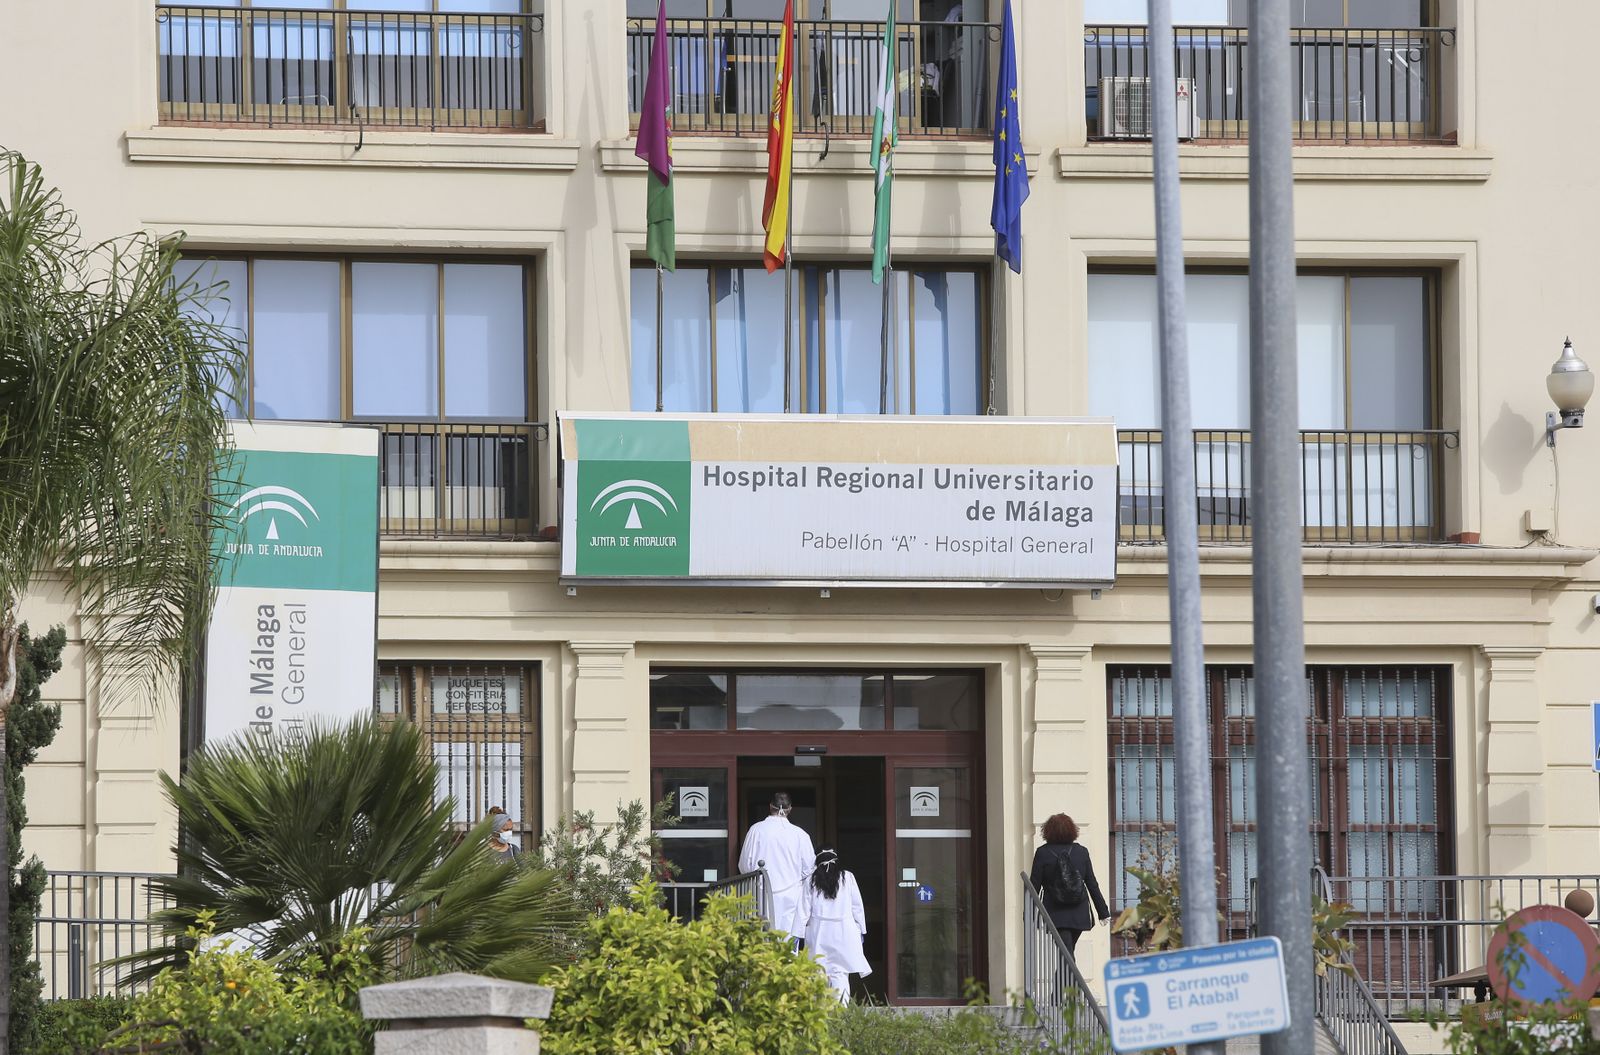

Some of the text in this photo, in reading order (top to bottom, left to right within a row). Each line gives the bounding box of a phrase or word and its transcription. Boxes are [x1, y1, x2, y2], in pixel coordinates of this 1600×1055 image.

[703, 465, 1094, 496] Hospital Regional Universitario
[965, 500, 1094, 528] de Málaga
[258, 544, 270, 556] DE
[590, 536, 616, 547] JUNTA
[620, 536, 630, 547] DE
[801, 531, 883, 553] Pabellón
[935, 535, 1016, 559] Hospital
[1020, 536, 1094, 556] General
[249, 604, 281, 695] Málaga
[281, 603, 307, 705] General
[1166, 971, 1249, 993] Carranque
[1168, 988, 1239, 1010] El Atabal
